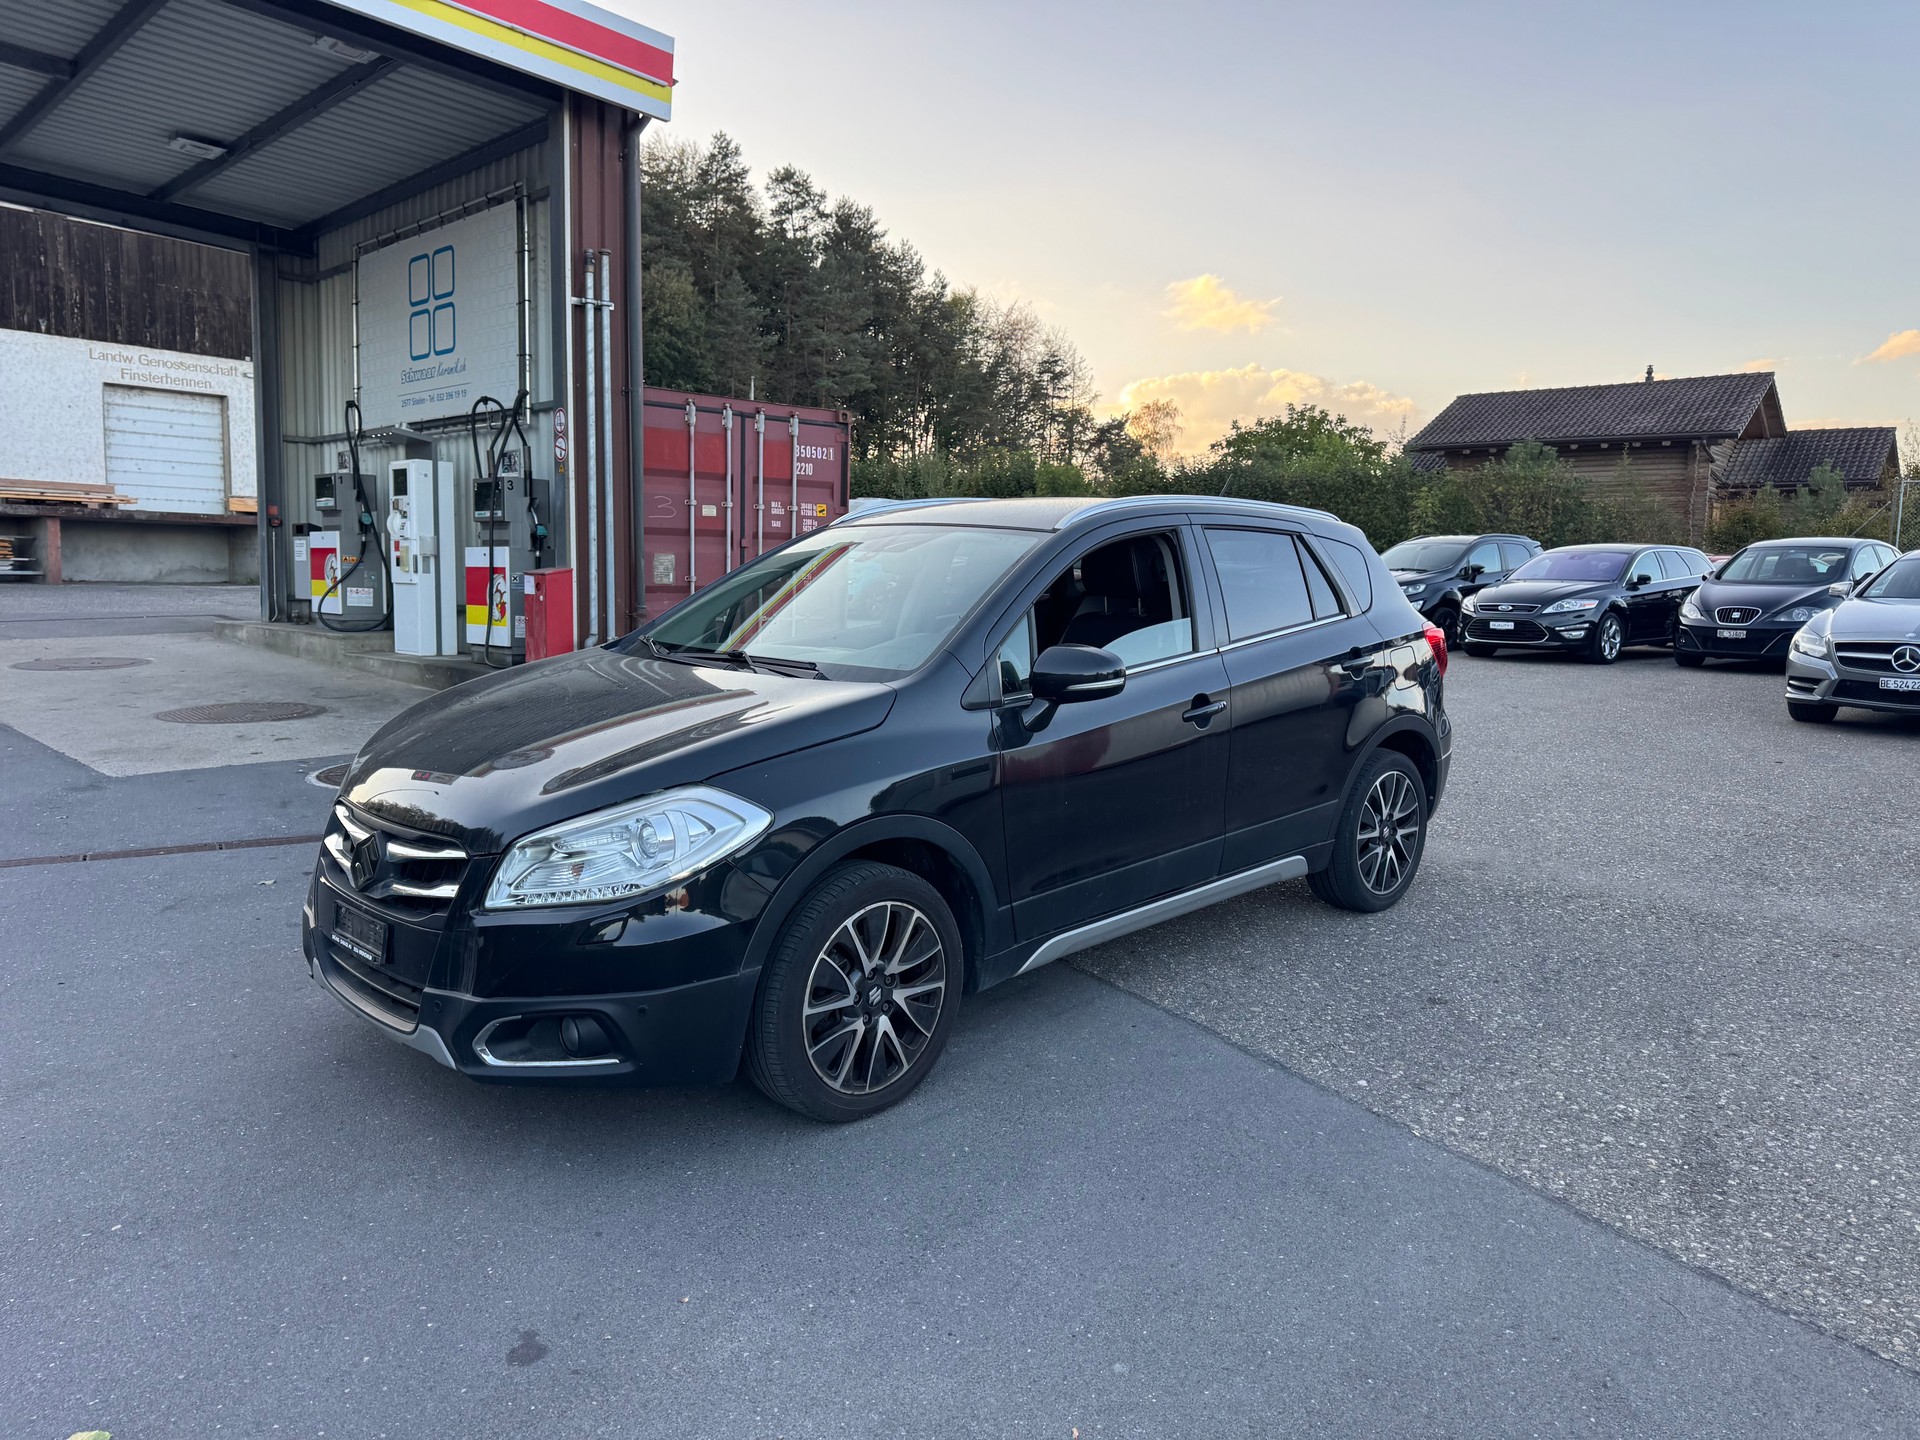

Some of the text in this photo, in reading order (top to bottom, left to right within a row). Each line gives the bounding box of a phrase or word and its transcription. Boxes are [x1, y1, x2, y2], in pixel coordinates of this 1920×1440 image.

[89, 347, 239, 377] Landw. Genossenschaft
[120, 367, 212, 389] Finsterhennen
[796, 462, 813, 476] 2210
[338, 475, 343, 484] 1
[507, 480, 513, 490] 3
[648, 495, 677, 518] 3
[771, 520, 781, 528] TARE
